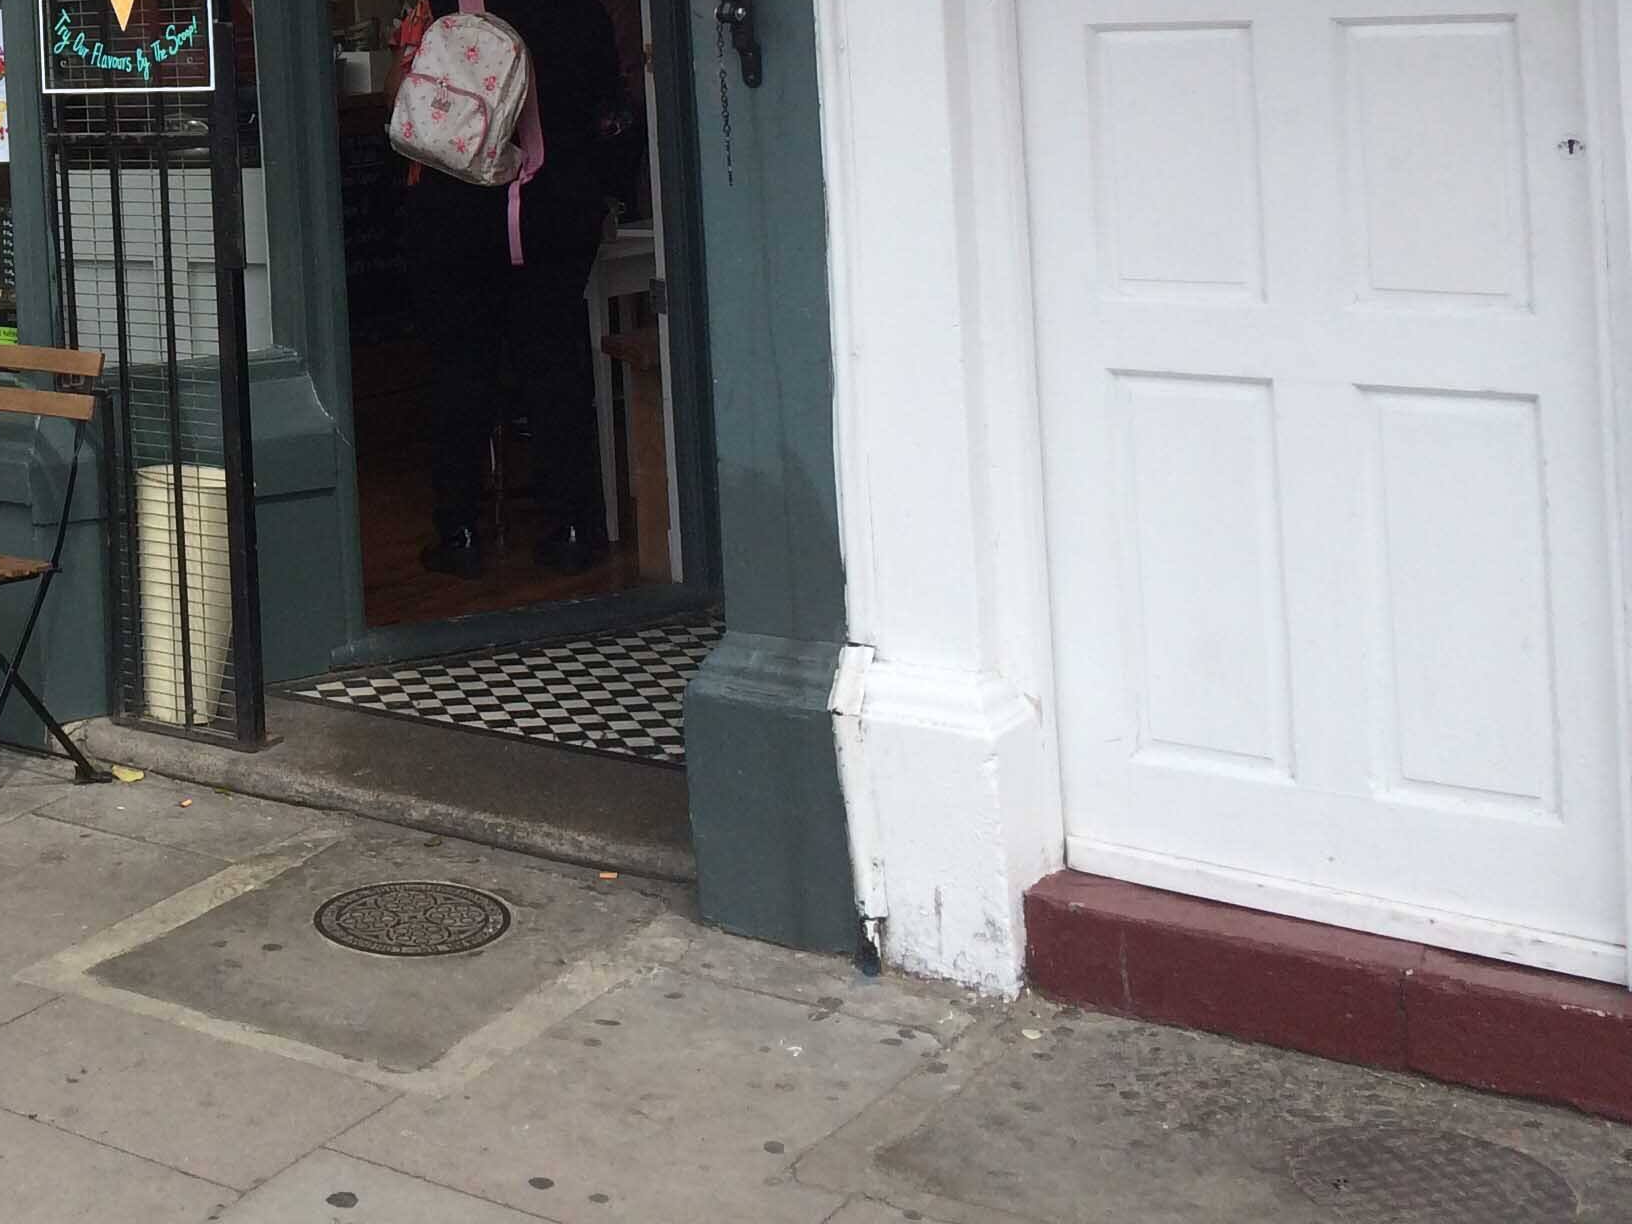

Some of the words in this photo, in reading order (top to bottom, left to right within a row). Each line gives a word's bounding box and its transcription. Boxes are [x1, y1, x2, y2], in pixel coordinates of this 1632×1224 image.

[53, 9, 71, 54] Try
[73, 32, 89, 58] Our
[91, 42, 132, 72] Flavours
[136, 48, 150, 80] By
[150, 40, 167, 62] The
[166, 16, 198, 55] Scoop!
